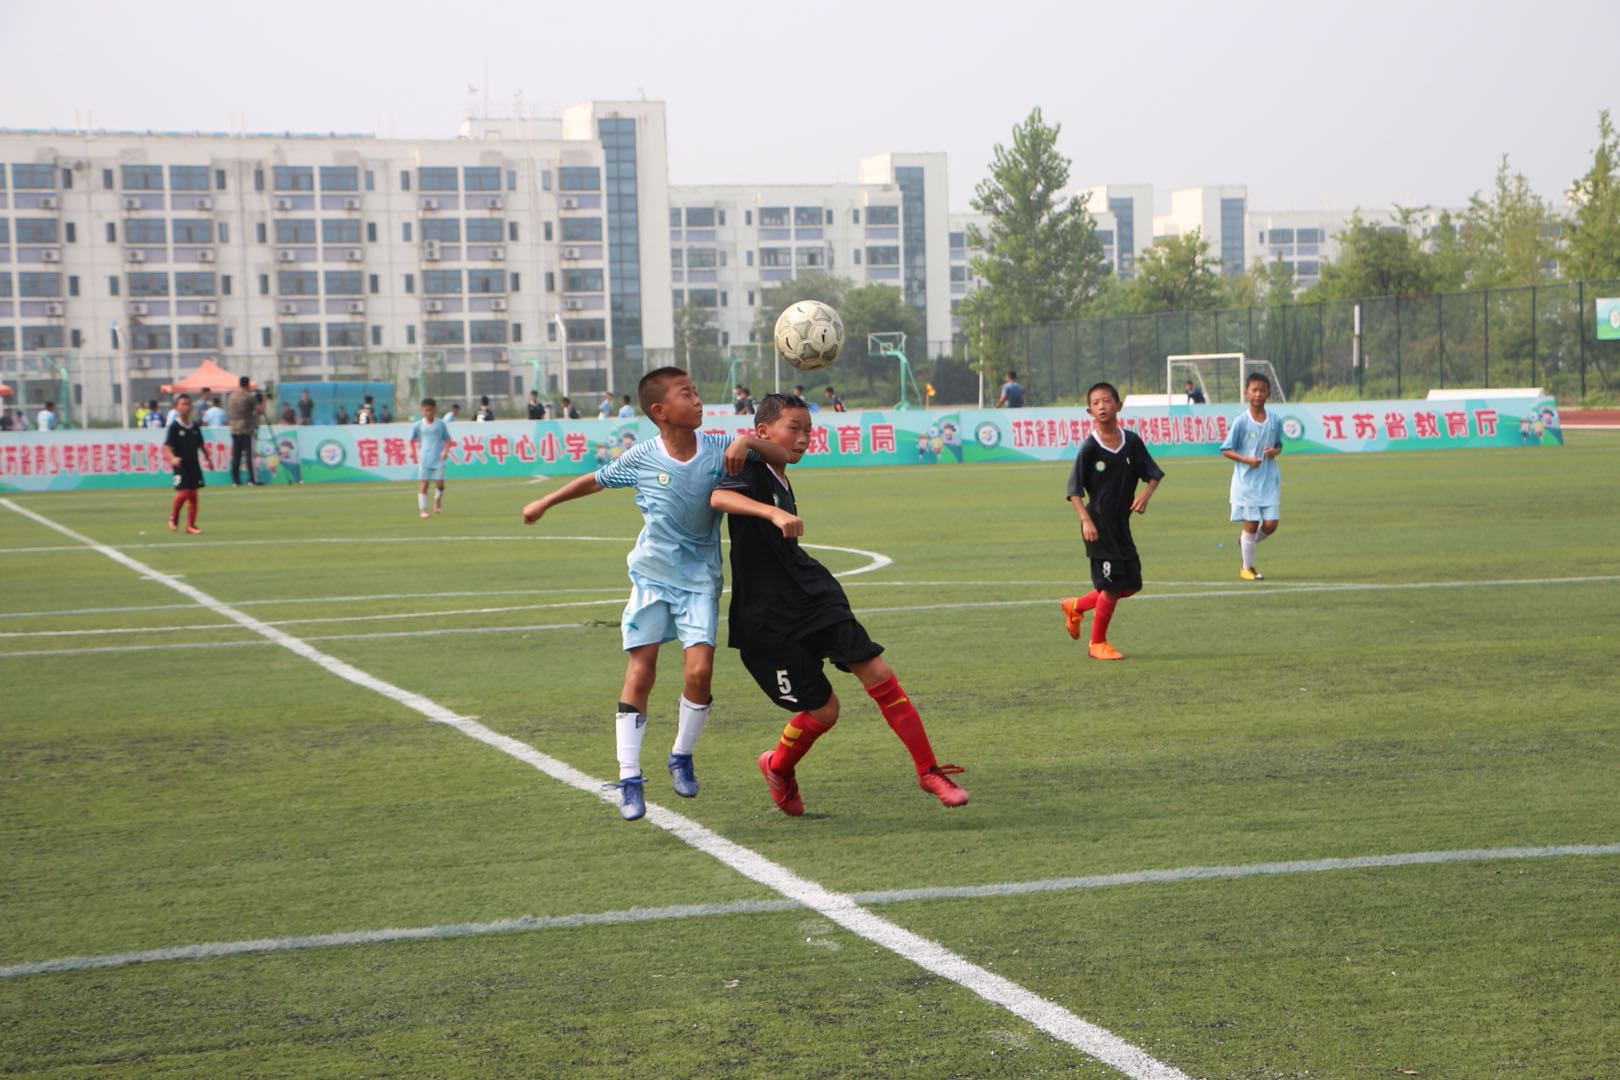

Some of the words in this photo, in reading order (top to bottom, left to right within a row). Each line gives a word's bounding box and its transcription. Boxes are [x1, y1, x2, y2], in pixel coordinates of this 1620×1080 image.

[1322, 409, 1498, 440] 江苏省教育厅
[356, 432, 589, 468] 宿豫大兴中心小学
[1102, 561, 1111, 577] 8
[776, 669, 792, 695] 5
